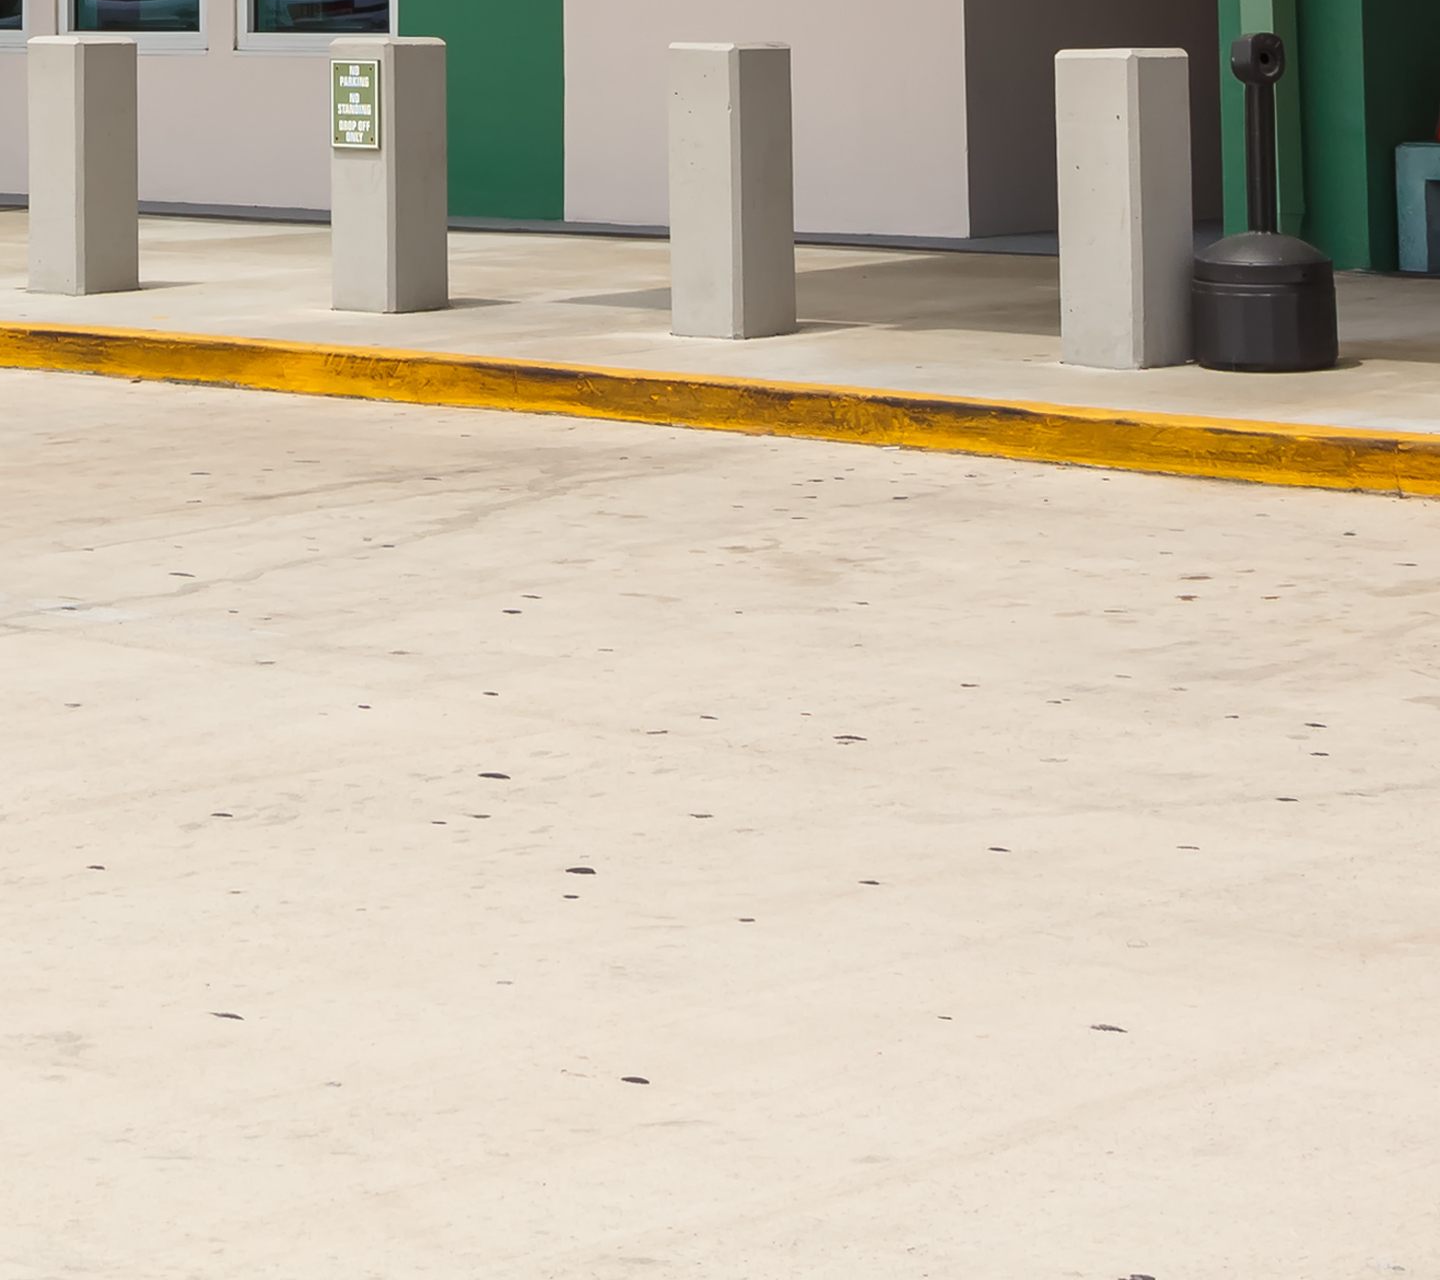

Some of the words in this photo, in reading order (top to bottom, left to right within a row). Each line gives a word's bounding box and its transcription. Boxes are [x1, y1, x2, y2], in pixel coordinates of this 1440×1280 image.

[339, 75, 370, 88] PARKING
[337, 103, 372, 116] STANDING
[338, 120, 357, 132] DROP
[357, 120, 371, 132] OFF
[345, 131, 364, 143] ONLY
